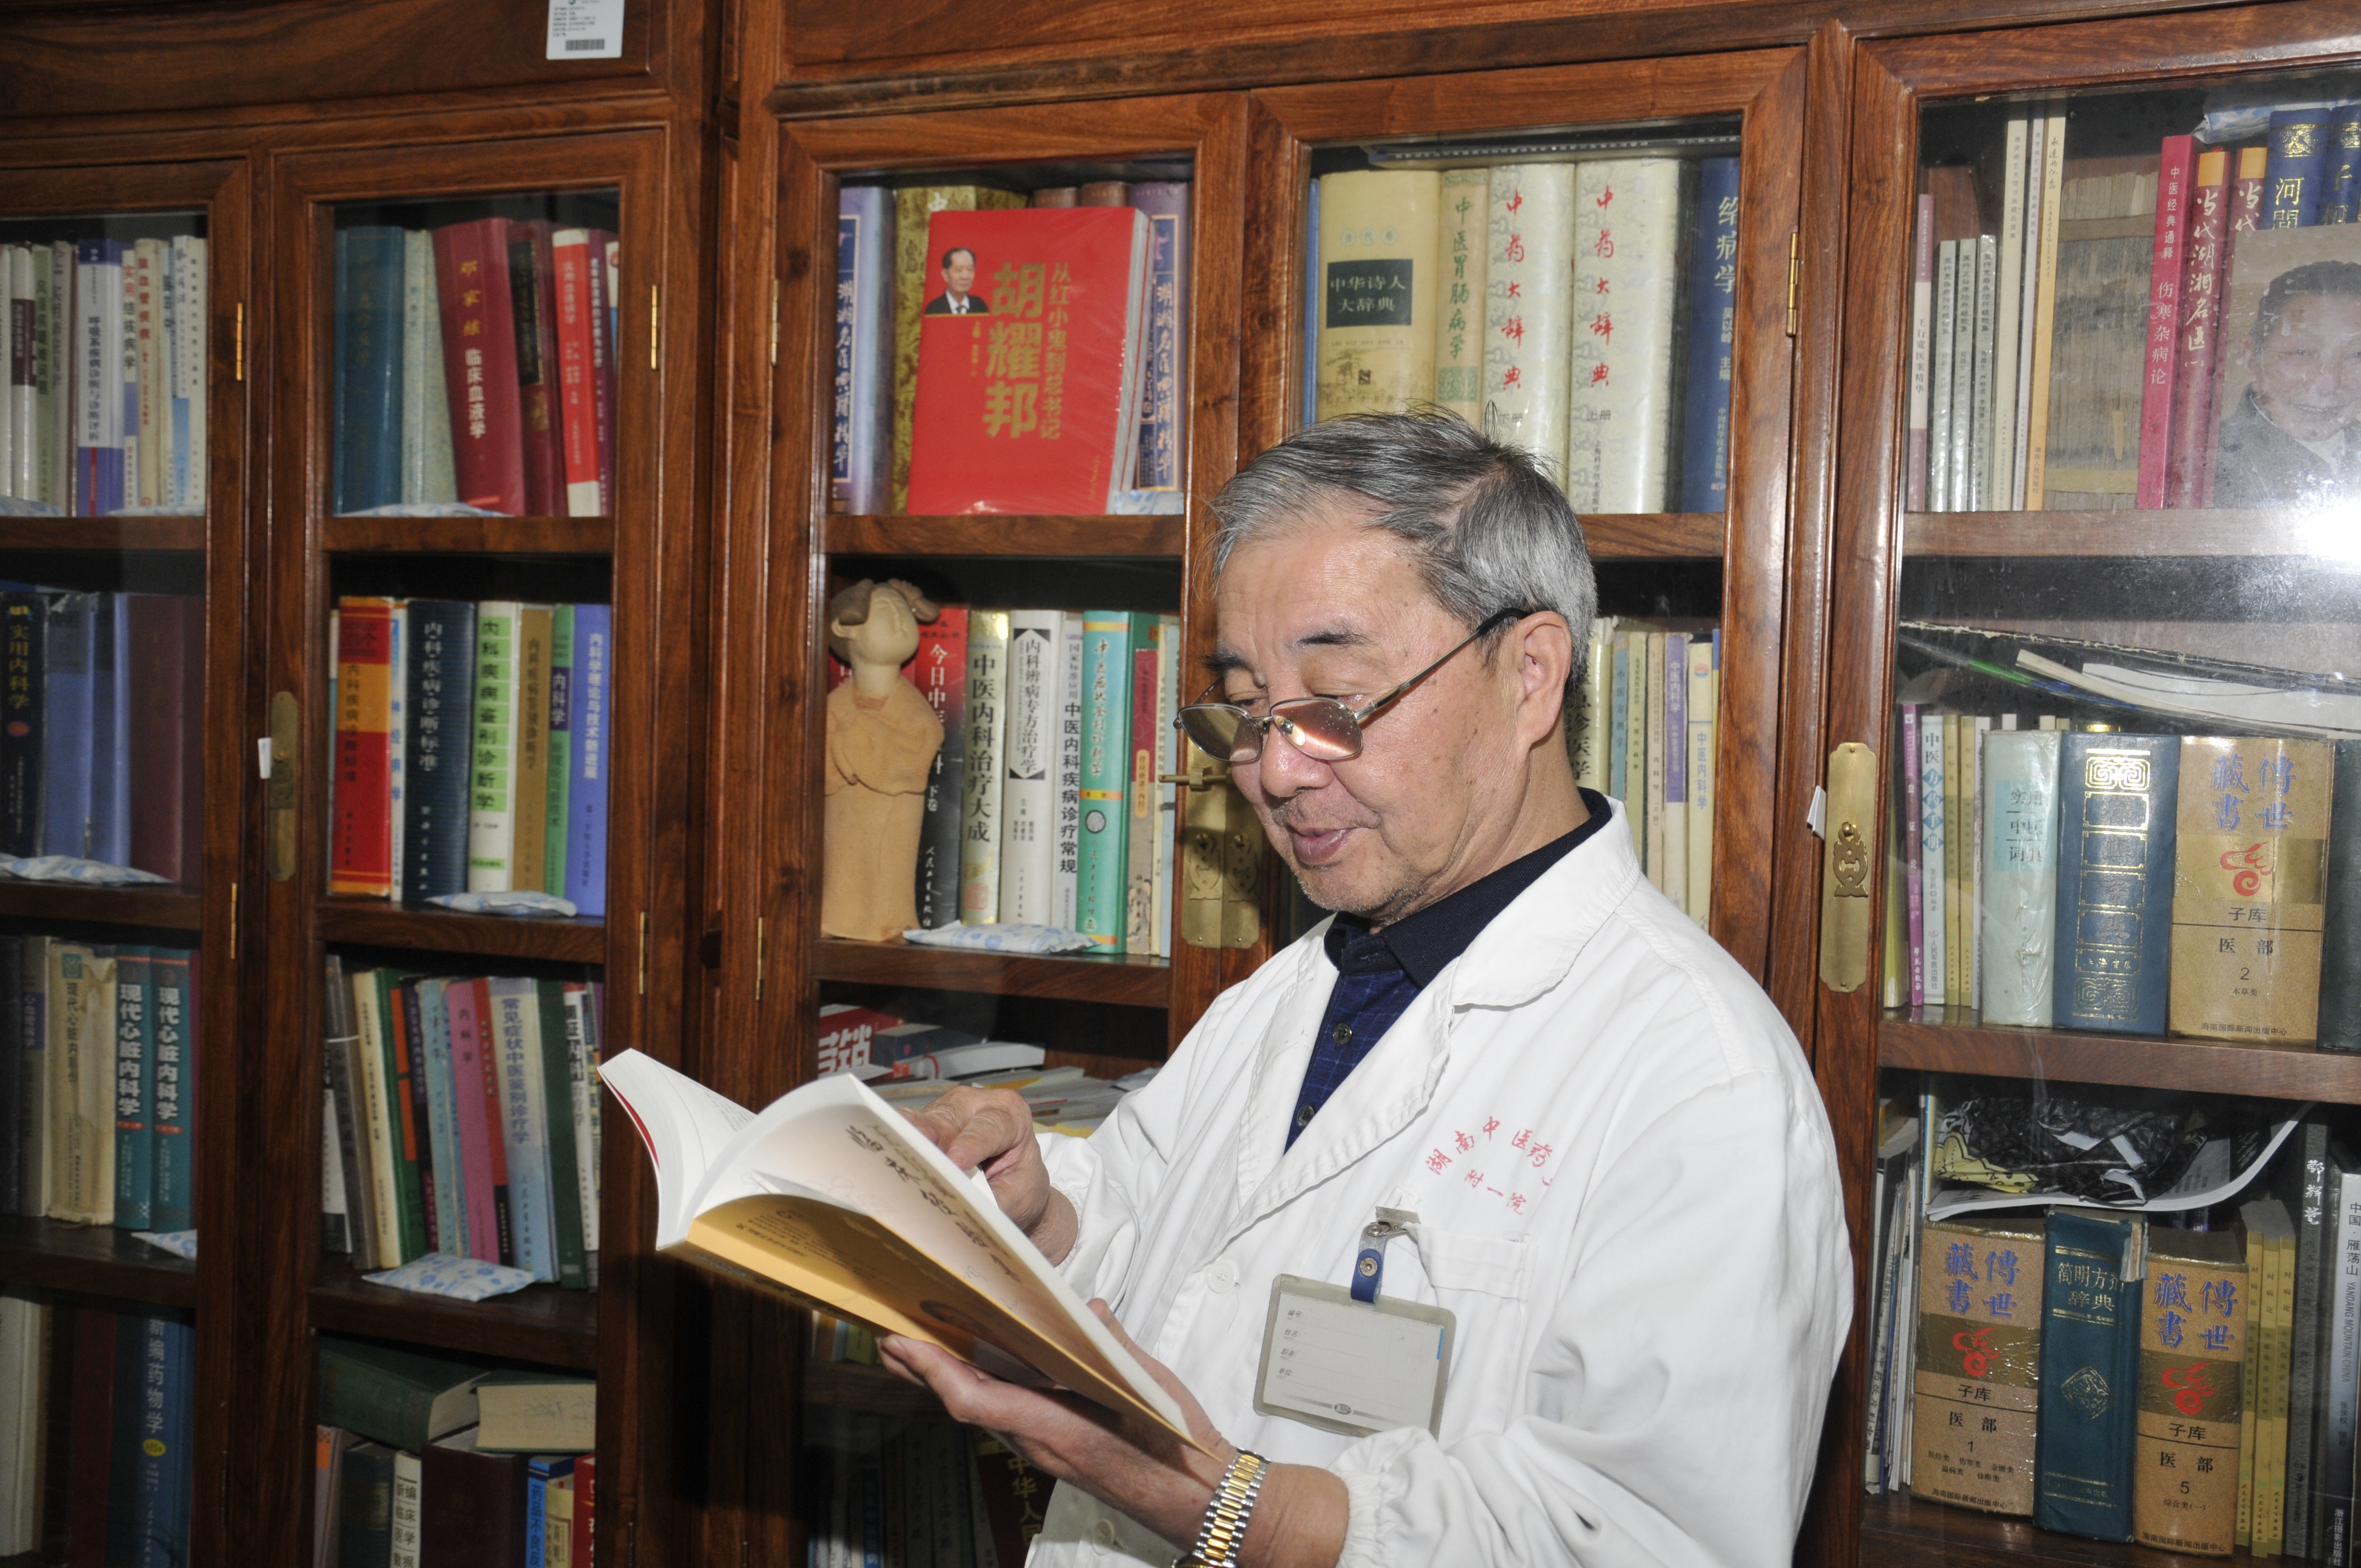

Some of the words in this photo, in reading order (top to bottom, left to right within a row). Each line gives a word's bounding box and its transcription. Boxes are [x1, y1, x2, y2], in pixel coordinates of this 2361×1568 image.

[2162, 166, 2180, 260] 中医经典通释
[1330, 275, 1406, 293] 中华诗人
[1448, 195, 1473, 361] 中医胃肠病学
[1500, 187, 1526, 391] 中药大辞典
[1589, 183, 1615, 389] 中药大辞典
[2187, 188, 2218, 352] 当代湖湘名医
[1337, 296, 1396, 314] 大辞典
[982, 262, 1046, 439] 胡耀邦
[1040, 261, 1072, 439] 从红小鬼到总书记
[2150, 281, 2175, 385] 伤寒杂病论
[465, 347, 487, 440] 临床血液学
[1586, 409, 1611, 422] 上册
[7, 623, 31, 709] 实用内科学
[1670, 661, 1681, 714] 中医内科学
[418, 621, 444, 772] 内科疾病诊断标准
[474, 620, 502, 810] 内科疾病鉴别诊断学
[1020, 639, 1041, 774] 内科辨病专方治疗学
[967, 654, 995, 843] 中医内科治疗大成
[1696, 731, 1707, 810] 中医内科学
[927, 784, 939, 812] 下卷
[1060, 702, 1081, 874] 中医内科疾病诊疗常规
[1924, 732, 1941, 851] 中医方药手册
[2010, 789, 2043, 806] 实用
[2008, 846, 2042, 863] 词典
[2228, 907, 2267, 923] 子库
[2240, 966, 2250, 981] 2
[118, 983, 143, 1117] 现代心脏内科学
[2201, 1022, 2287, 1037] 海南国际新闻出版中心
[156, 986, 180, 1121] 现代心脏内科学
[2068, 1291, 2115, 1313] 辞典
[2250, 1266, 2259, 1306] 时病论
[2266, 1272, 2275, 1314] 时病论
[2282, 1271, 2292, 1312] 时病论
[2344, 1281, 2356, 1317] YANDANG
[2342, 1319, 2355, 1358] MOUNTAIN
[146, 1316, 165, 1435] 新编药物学
[1957, 1384, 1992, 1402] 子库
[2341, 1359, 2352, 1382] CHINA
[1967, 1440, 1974, 1453] 1
[2169, 1422, 2207, 1441] 子库
[1932, 1488, 2008, 1510] 海南国际新闻出版中心
[2180, 1480, 2191, 1494] 5
[2142, 1531, 2226, 1553] 海南国际新闻出版中心
[2332, 1507, 2345, 1567] 浙江摄影出版社
